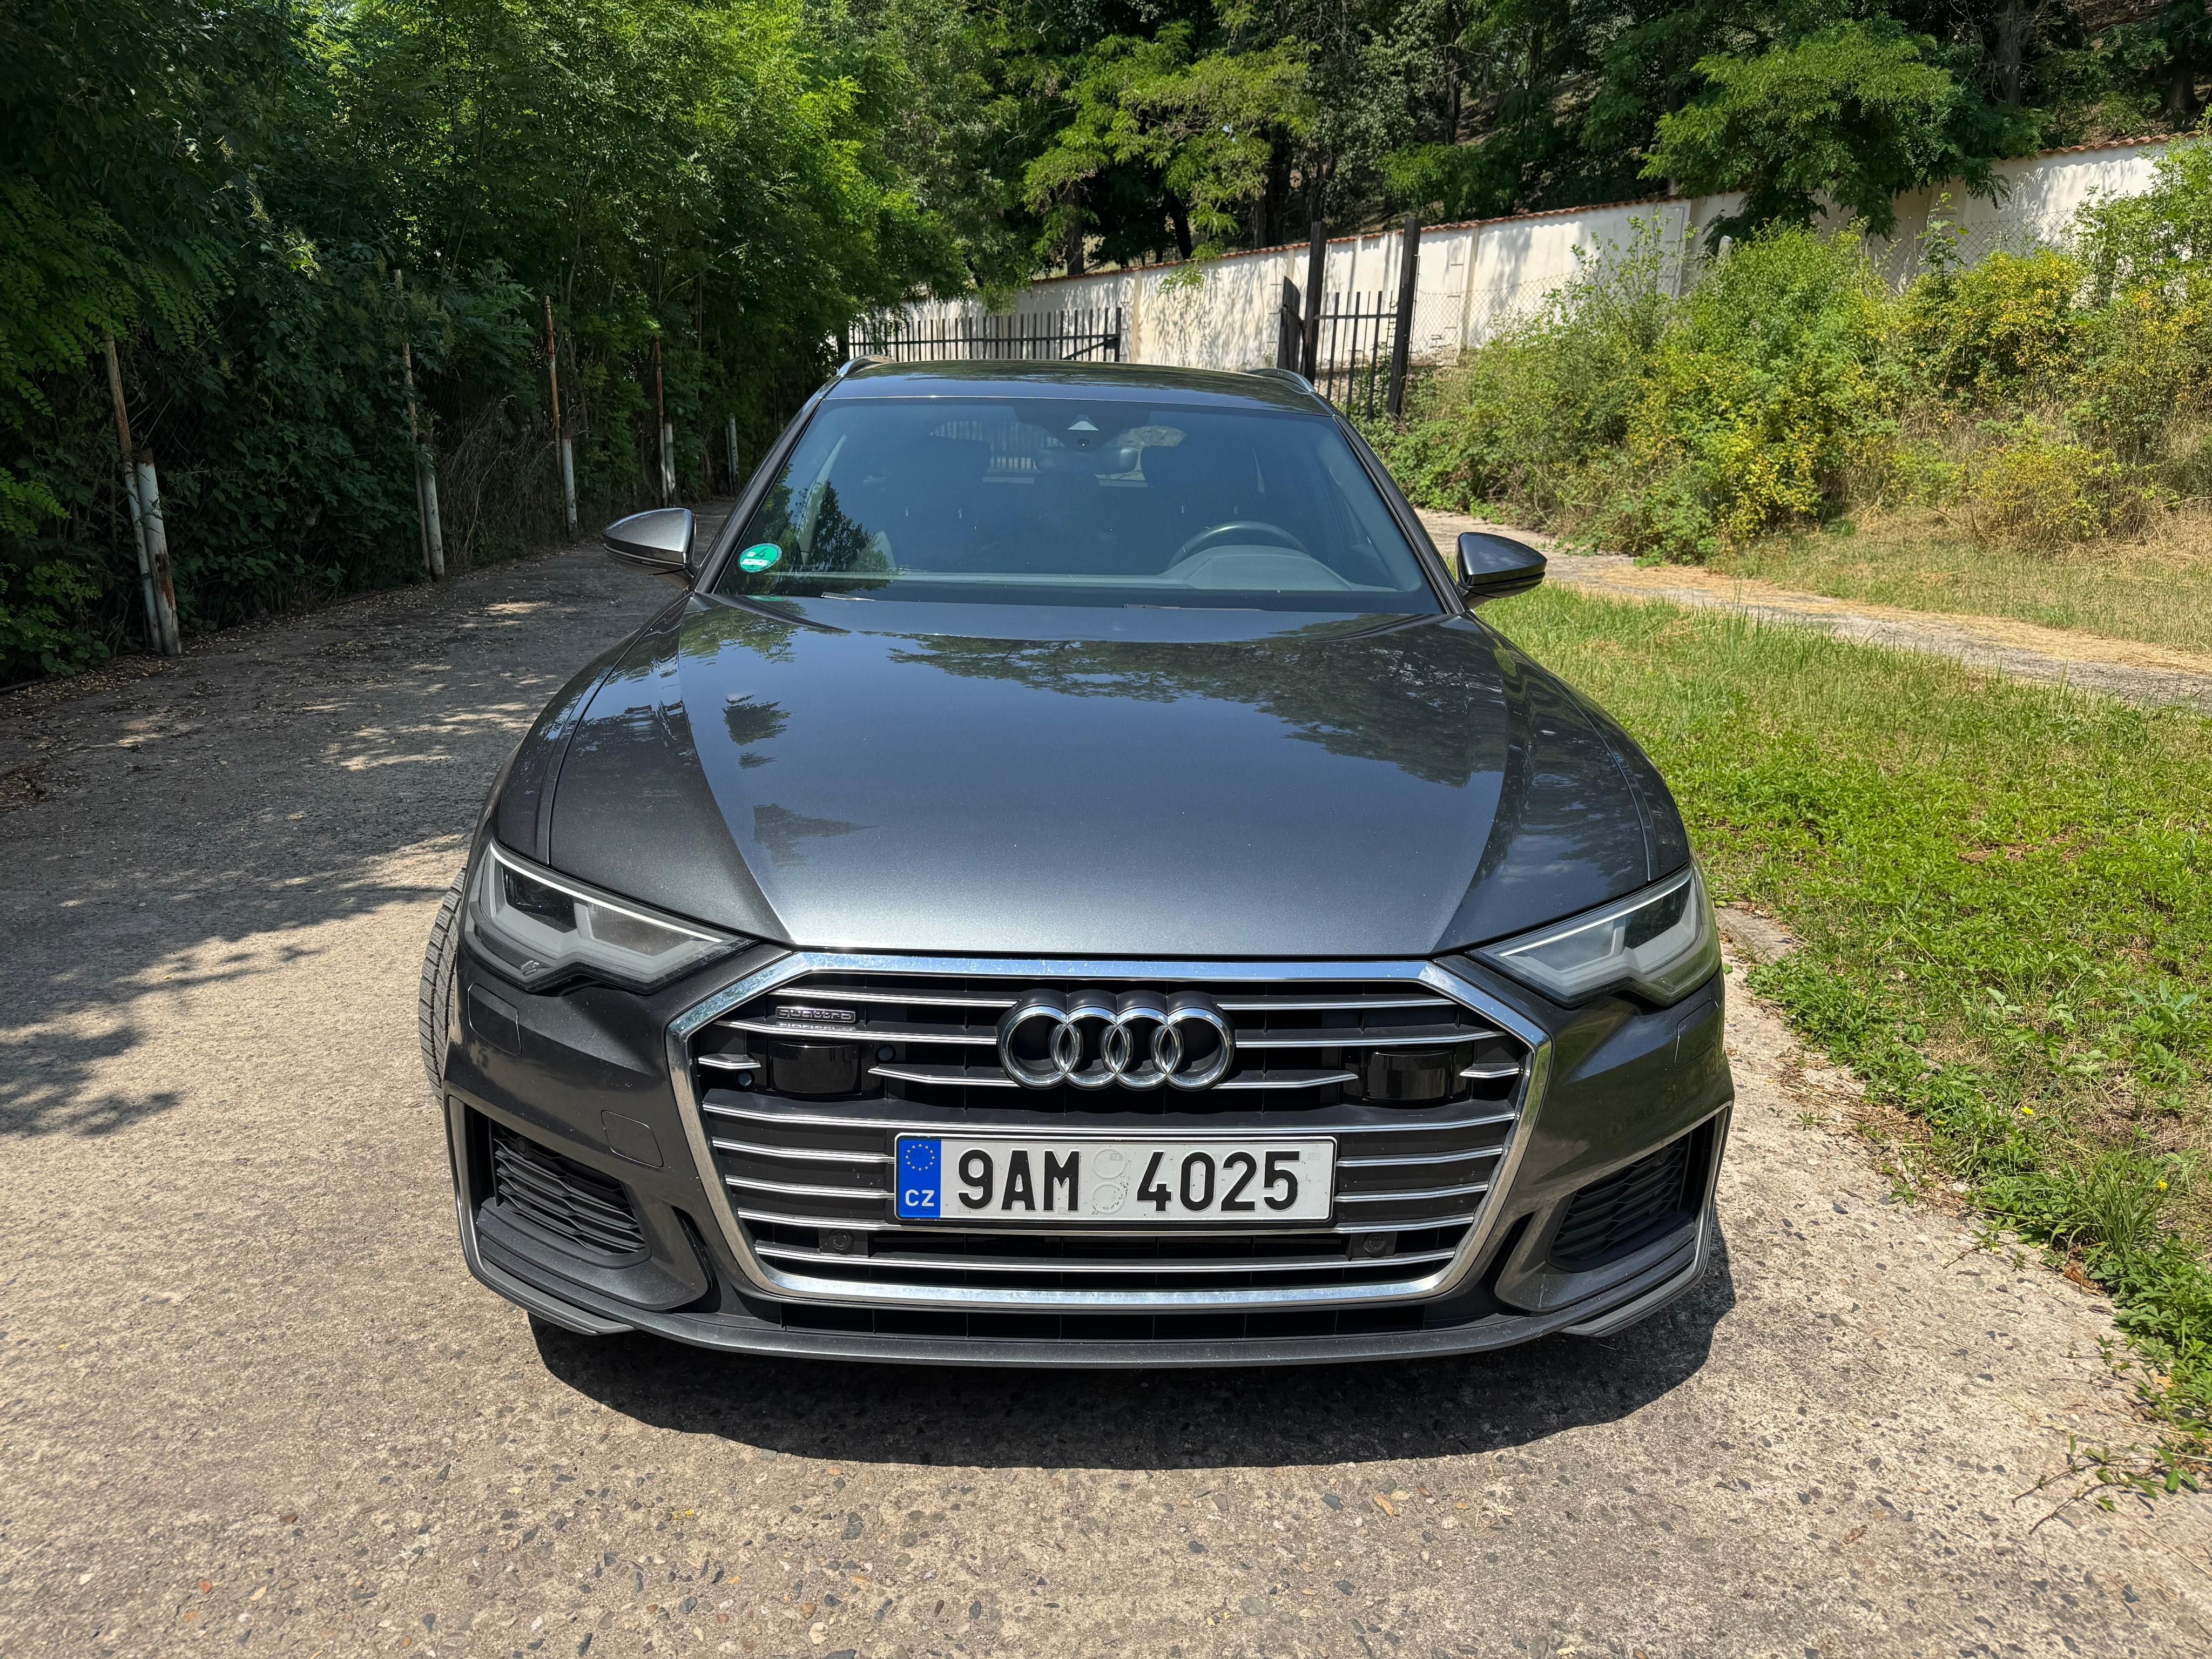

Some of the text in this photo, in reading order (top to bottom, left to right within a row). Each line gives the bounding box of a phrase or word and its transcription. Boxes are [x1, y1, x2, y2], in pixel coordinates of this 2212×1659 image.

[756, 548, 768, 558] 4
[779, 1009, 852, 1021] quattro
[958, 1149, 1300, 1211] 9AM 4025
[905, 1189, 935, 1206] CZ
